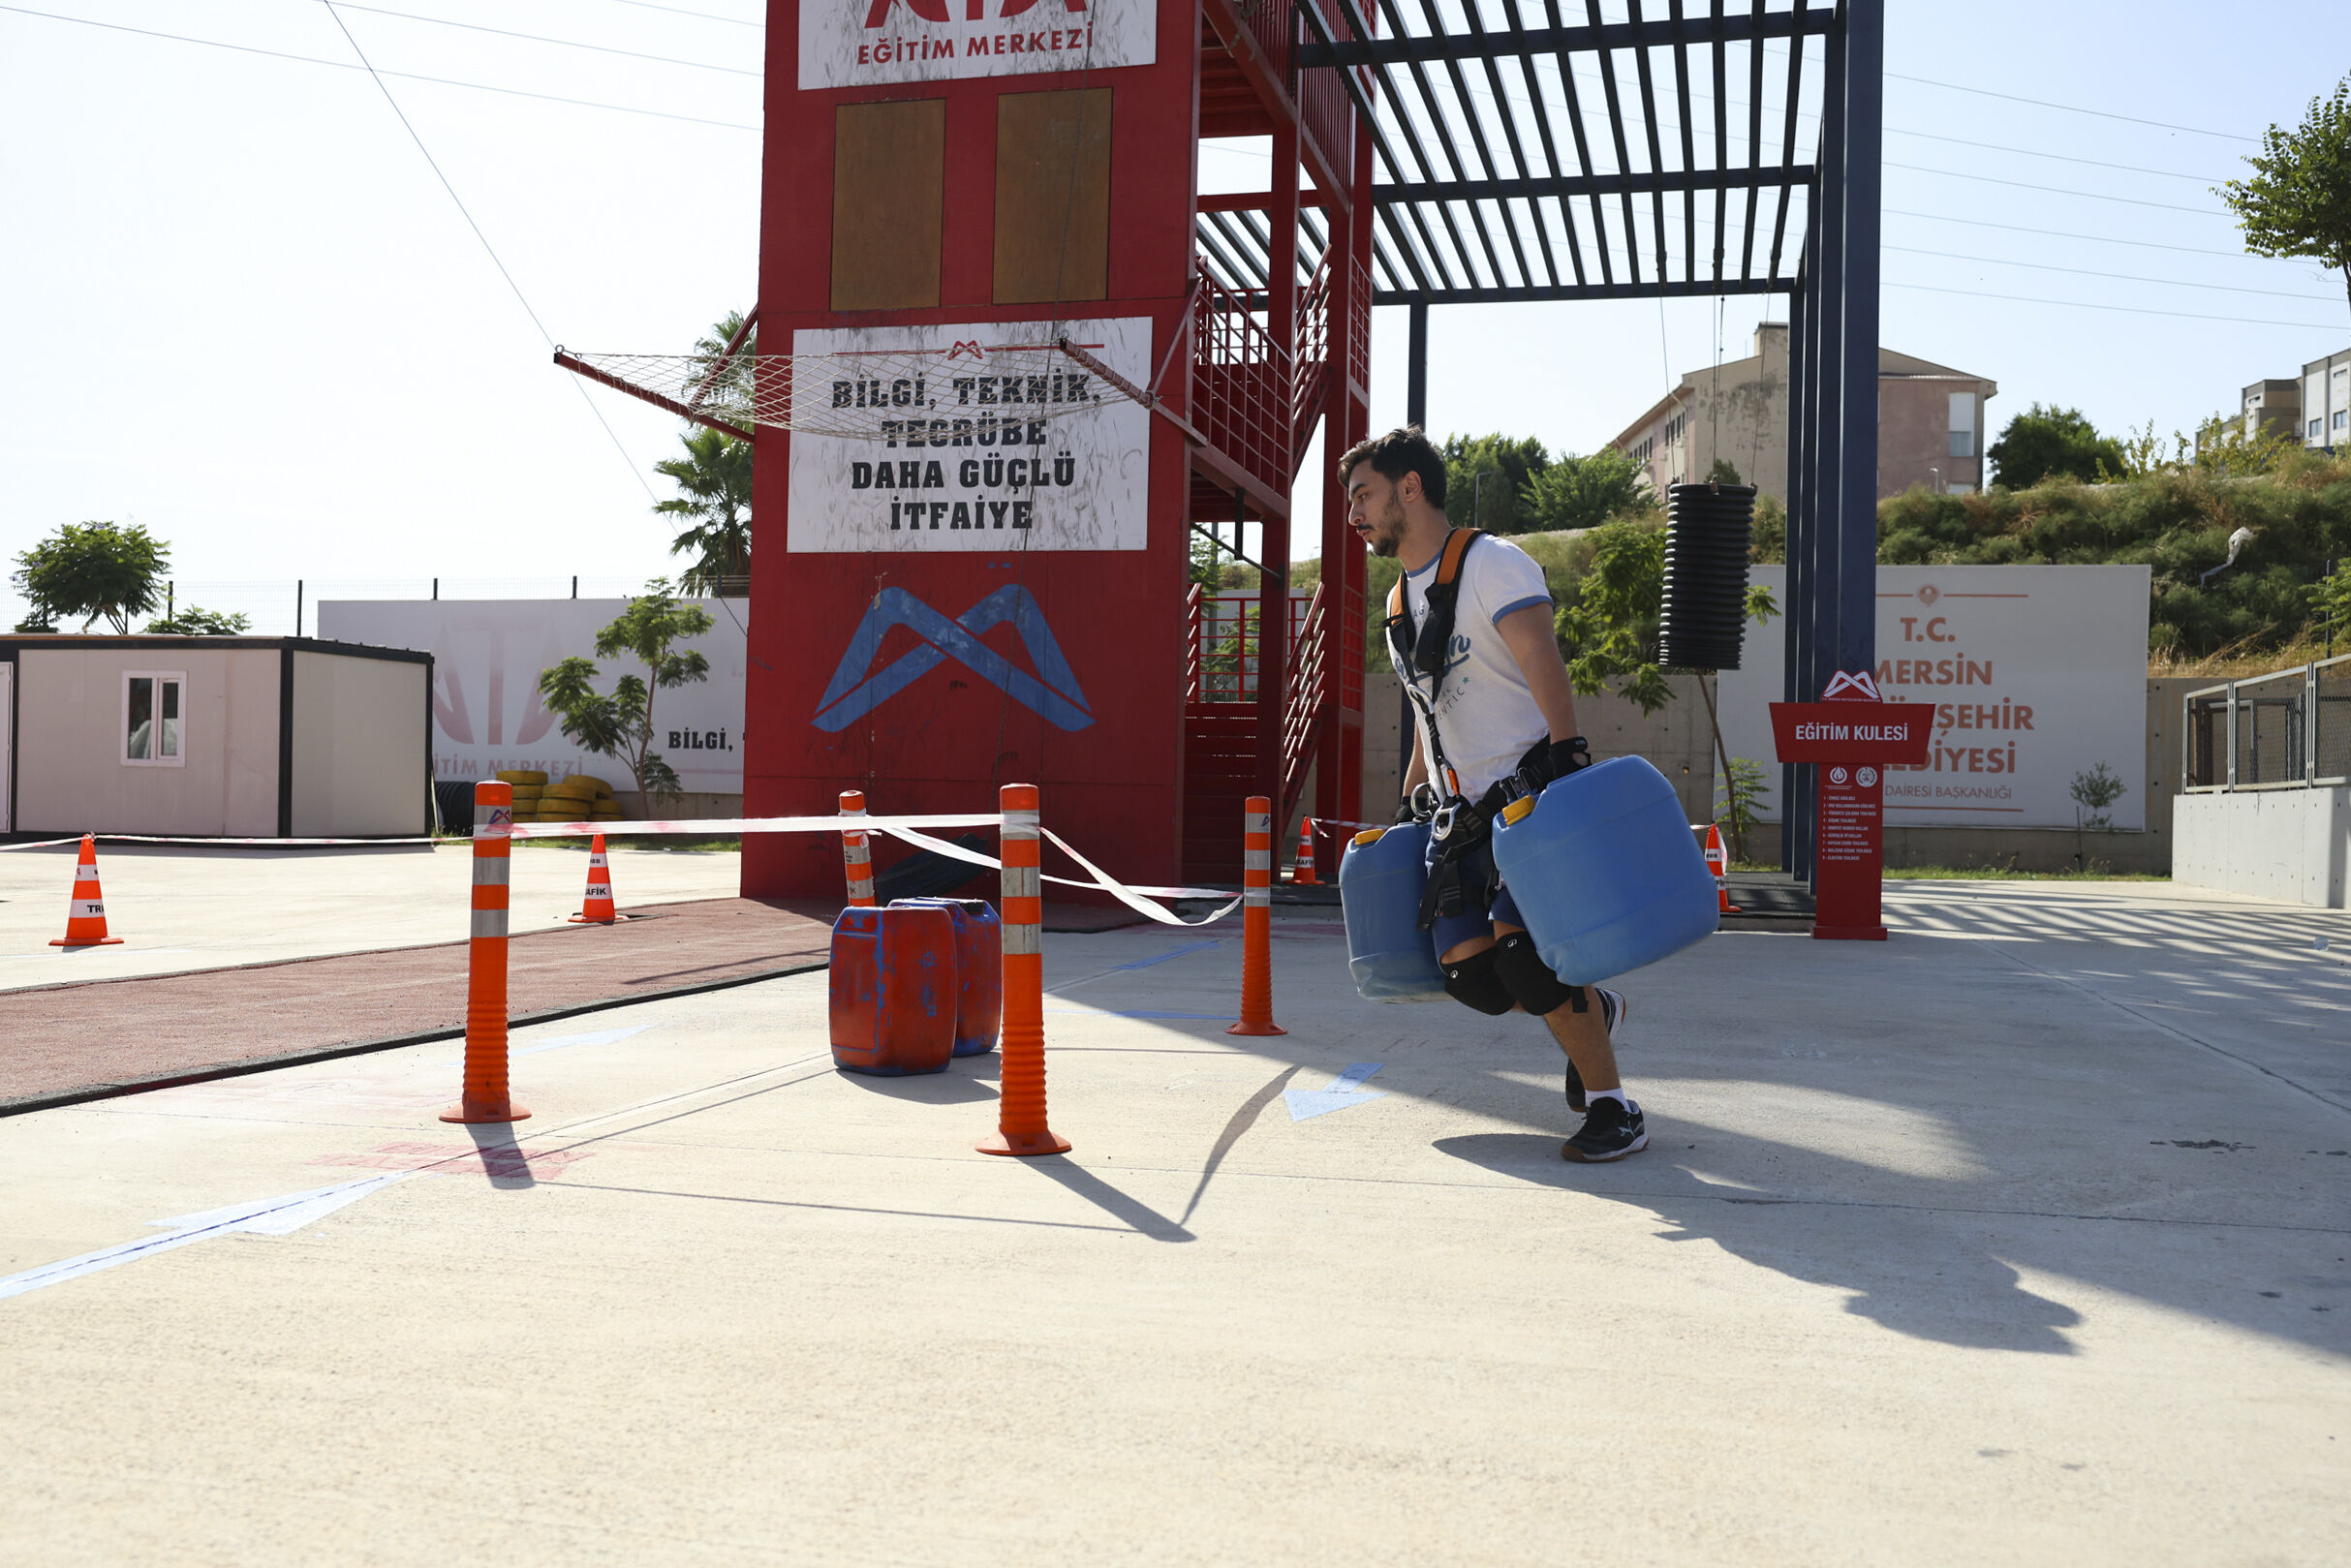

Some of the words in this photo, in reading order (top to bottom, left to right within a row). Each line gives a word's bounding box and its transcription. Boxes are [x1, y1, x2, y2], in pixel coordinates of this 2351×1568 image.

[857, 35, 955, 65] EĞİTİM
[967, 21, 1093, 57] MERKEZİ
[832, 372, 937, 410] BİLGİ,
[953, 368, 1101, 406] TEKNİK,
[882, 411, 1047, 448] TECRÜBE
[851, 460, 944, 489] DAHA
[959, 450, 1076, 495] GÜÇLÜ
[890, 494, 1033, 530] İTFAİYE
[1900, 616, 1956, 642] T.C.
[1795, 722, 1849, 741] EĞİTİM
[1853, 723, 1908, 741] KULESİ
[1932, 696, 2035, 737] ŞEHİR
[668, 726, 733, 752] BİLGİ,
[435, 753, 479, 775] İTİM
[1884, 783, 1933, 798] DAİRESİ
[1935, 784, 2012, 800] BAŞKANLIĞI
[585, 886, 606, 896] AFİK
